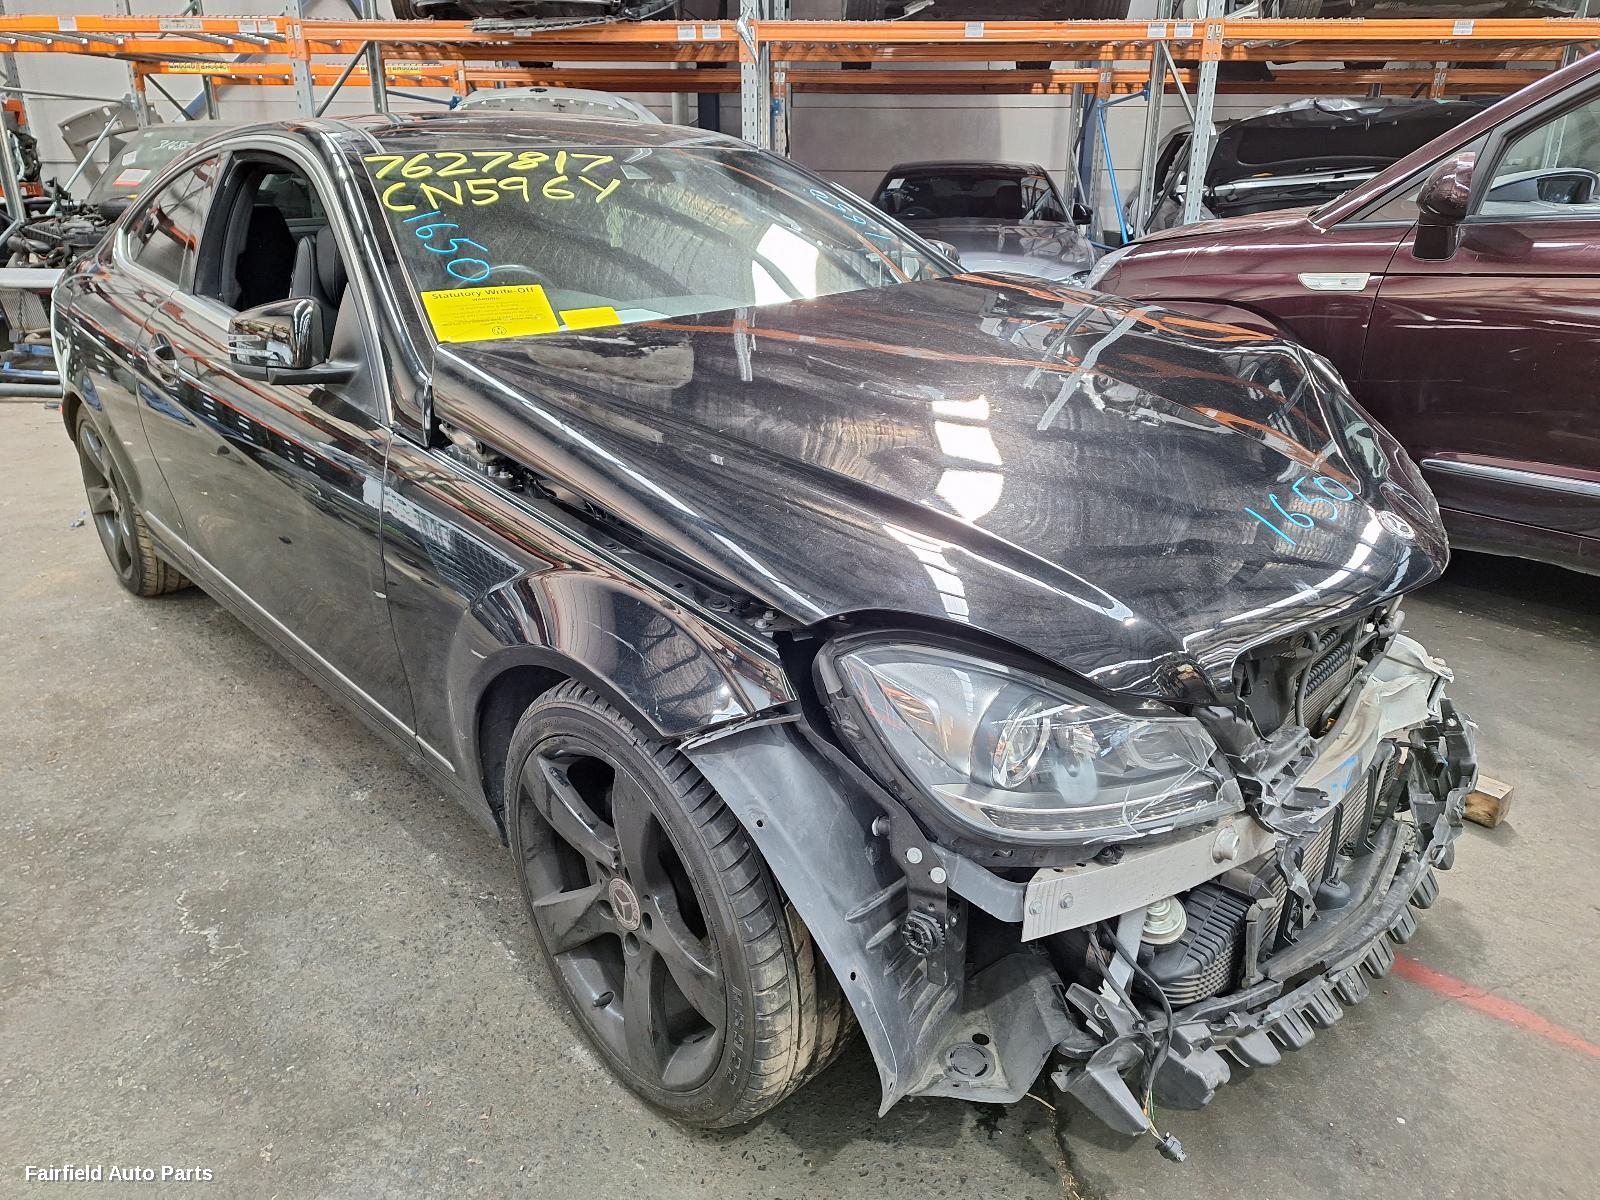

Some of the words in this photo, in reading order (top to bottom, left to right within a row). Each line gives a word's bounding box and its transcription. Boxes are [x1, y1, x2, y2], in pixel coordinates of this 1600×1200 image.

[364, 150, 614, 179] 7627817
[382, 175, 621, 212] CN596Y
[432, 291, 482, 300] Statutory
[485, 286, 535, 296] Write-Off
[1242, 475, 1354, 545] 1650
